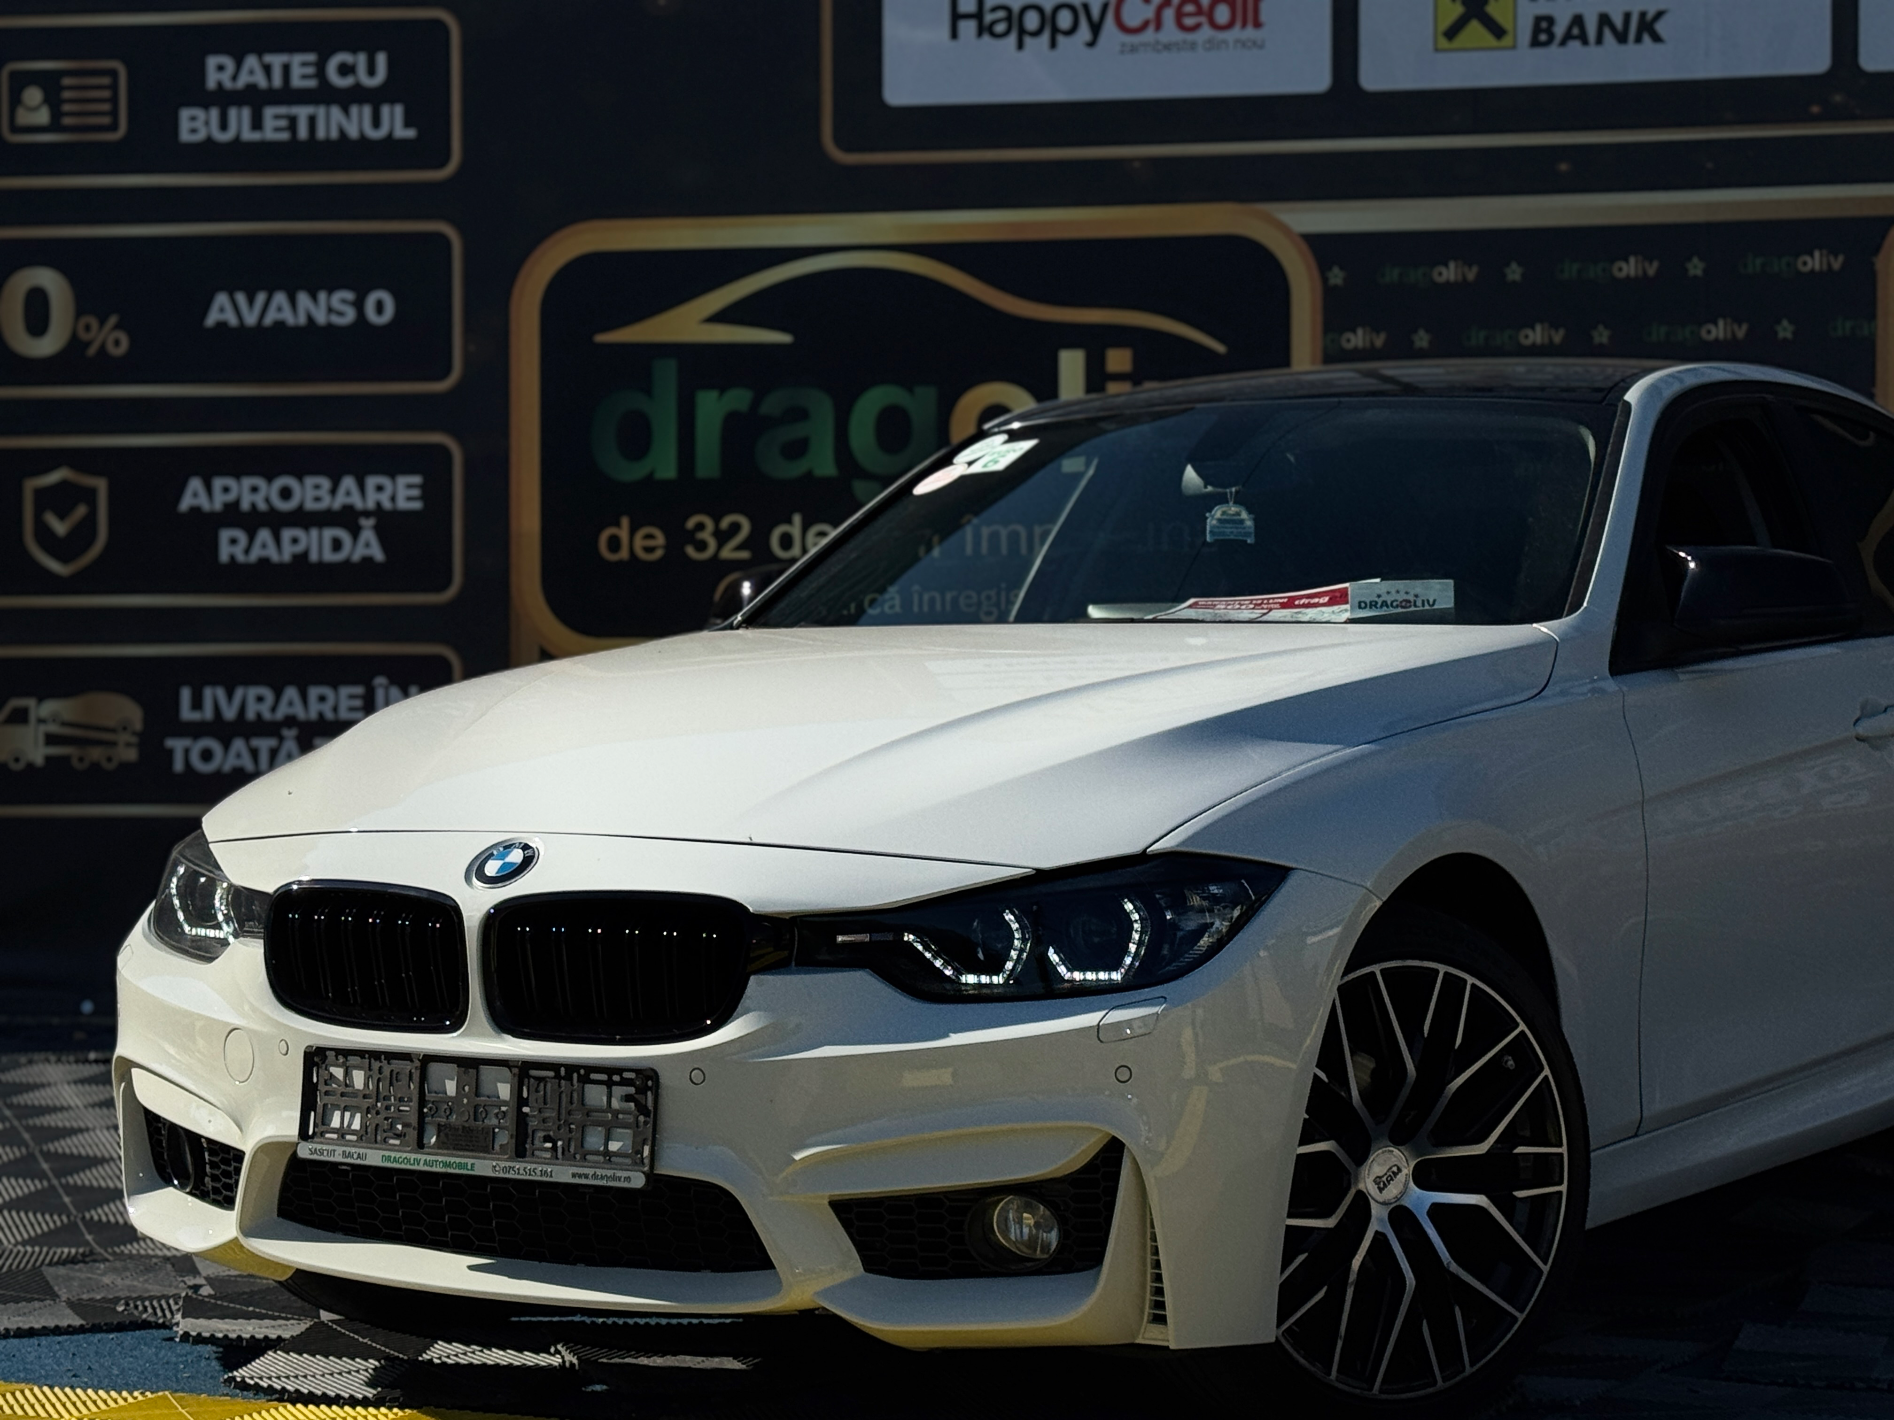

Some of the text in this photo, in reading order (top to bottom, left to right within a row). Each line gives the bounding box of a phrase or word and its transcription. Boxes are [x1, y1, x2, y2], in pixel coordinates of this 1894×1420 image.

[1529, 9, 1668, 48] BANK
[1119, 35, 1265, 55] zambeste din nou
[204, 50, 389, 91] RATE CU
[177, 102, 418, 144] BULETINUL
[1376, 259, 1480, 288] dragoliv
[1556, 254, 1660, 284] dragoliv
[1738, 247, 1845, 278] dragoliv
[203, 289, 397, 328] AVANS 0
[1462, 321, 1567, 350] dragoliv
[1642, 316, 1749, 347] dragoliv
[1828, 315, 1877, 339] dra
[177, 474, 424, 513] APROBARE
[217, 516, 386, 564] RAPIDĂ
[598, 515, 666, 561] de
[684, 513, 752, 560] 32
[1357, 597, 1437, 610] DRAGOLIV
[178, 685, 366, 722] LIVRARE
[163, 727, 302, 774] TOATĂ
[381, 1154, 476, 1172] DRAGOLIV AUTOMOBILE
[571, 1171, 632, 1185] www.dragoliv.ro
